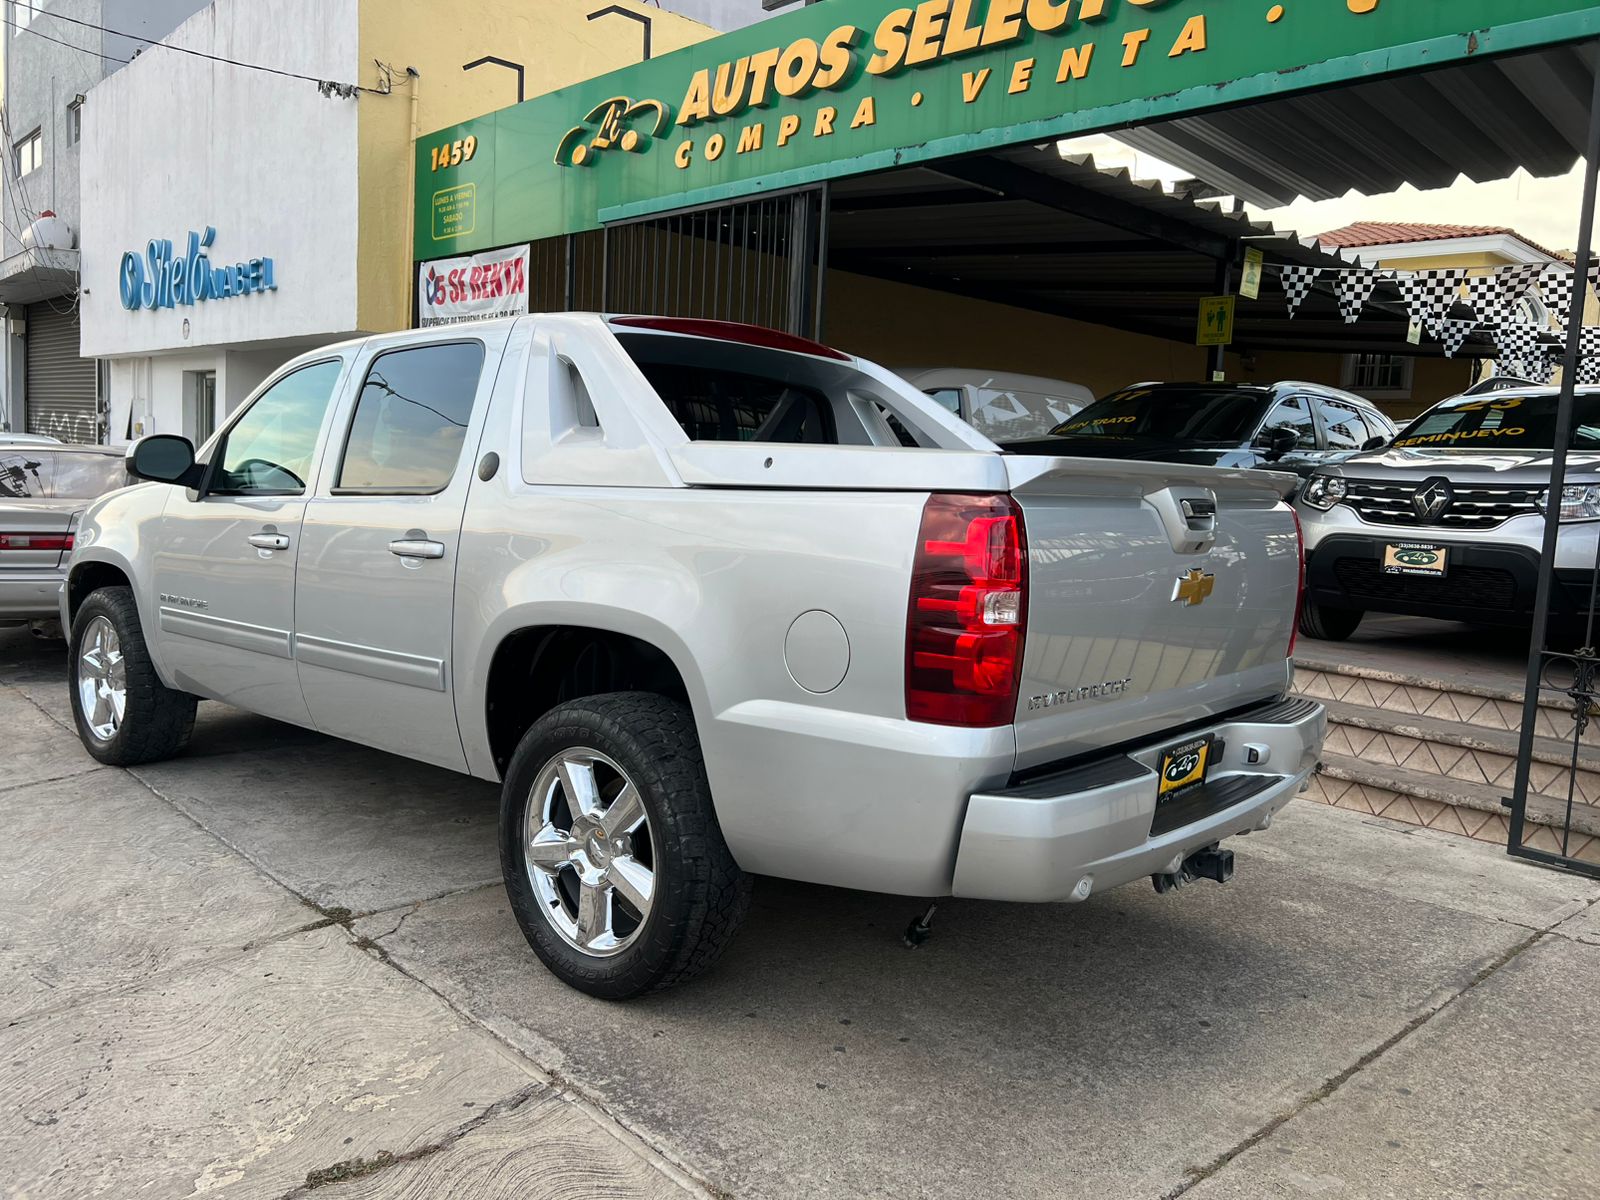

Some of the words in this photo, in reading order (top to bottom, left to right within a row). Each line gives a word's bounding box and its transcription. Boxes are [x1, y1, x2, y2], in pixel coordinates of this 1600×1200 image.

[675, 25, 857, 125] AUTOS
[865, 0, 1152, 75] SELEC
[675, 96, 876, 169] COMPRA
[961, 15, 1207, 102] VENTA
[431, 135, 477, 172] 1459
[448, 268, 468, 304] SE
[469, 256, 525, 301] RENTA
[1092, 415, 1137, 426] TRATO
[1455, 397, 1526, 412] 23
[1393, 427, 1527, 448] SEMINUEVO
[1027, 678, 1132, 711] AVALANCHE
